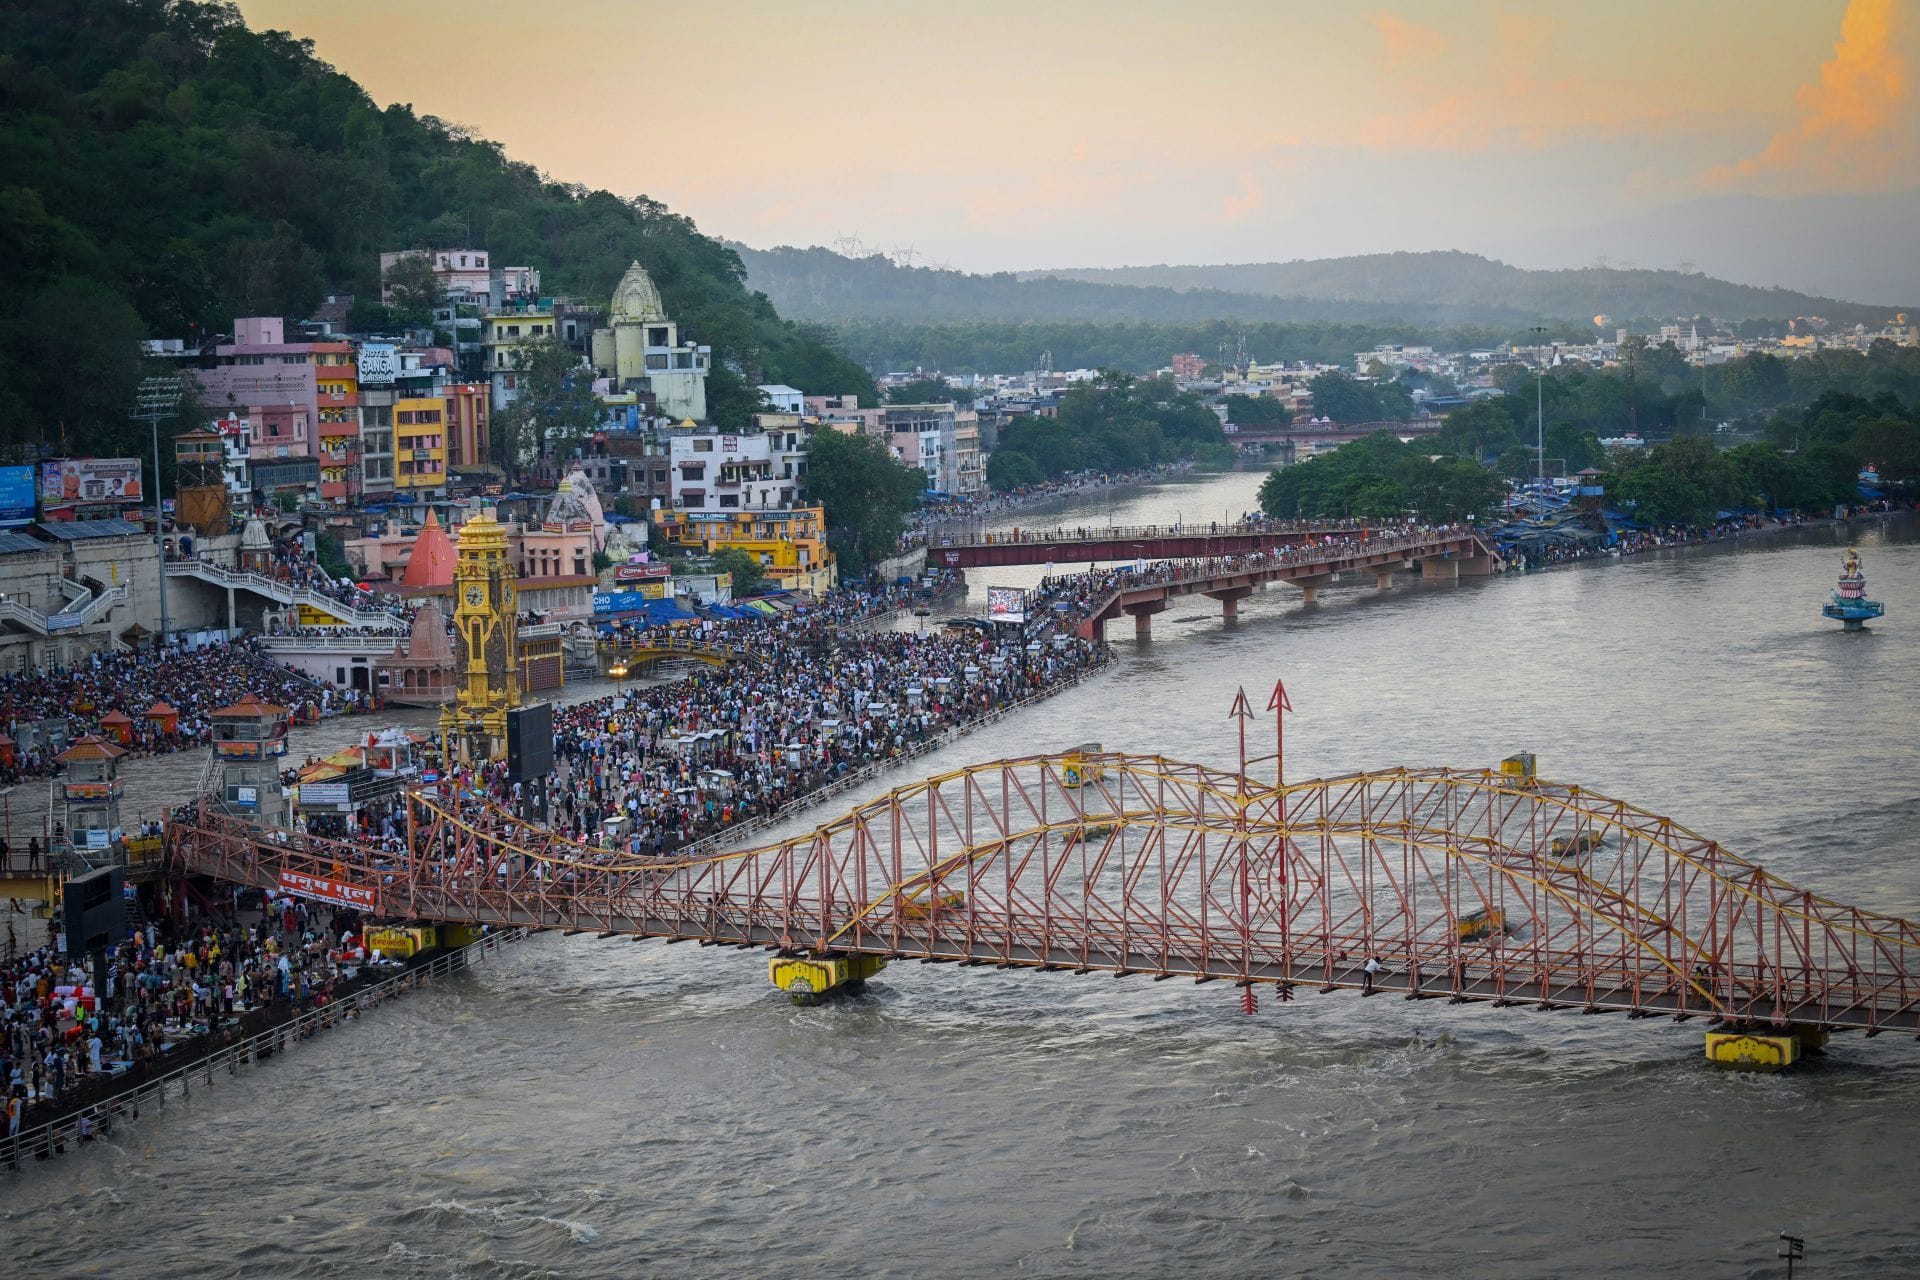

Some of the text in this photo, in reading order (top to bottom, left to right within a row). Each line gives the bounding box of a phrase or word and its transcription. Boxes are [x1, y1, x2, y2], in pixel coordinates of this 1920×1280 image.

[364, 350, 389, 358] HOTEL
[361, 360, 394, 375] GANGA
[363, 375, 392, 383] DARSHAN
